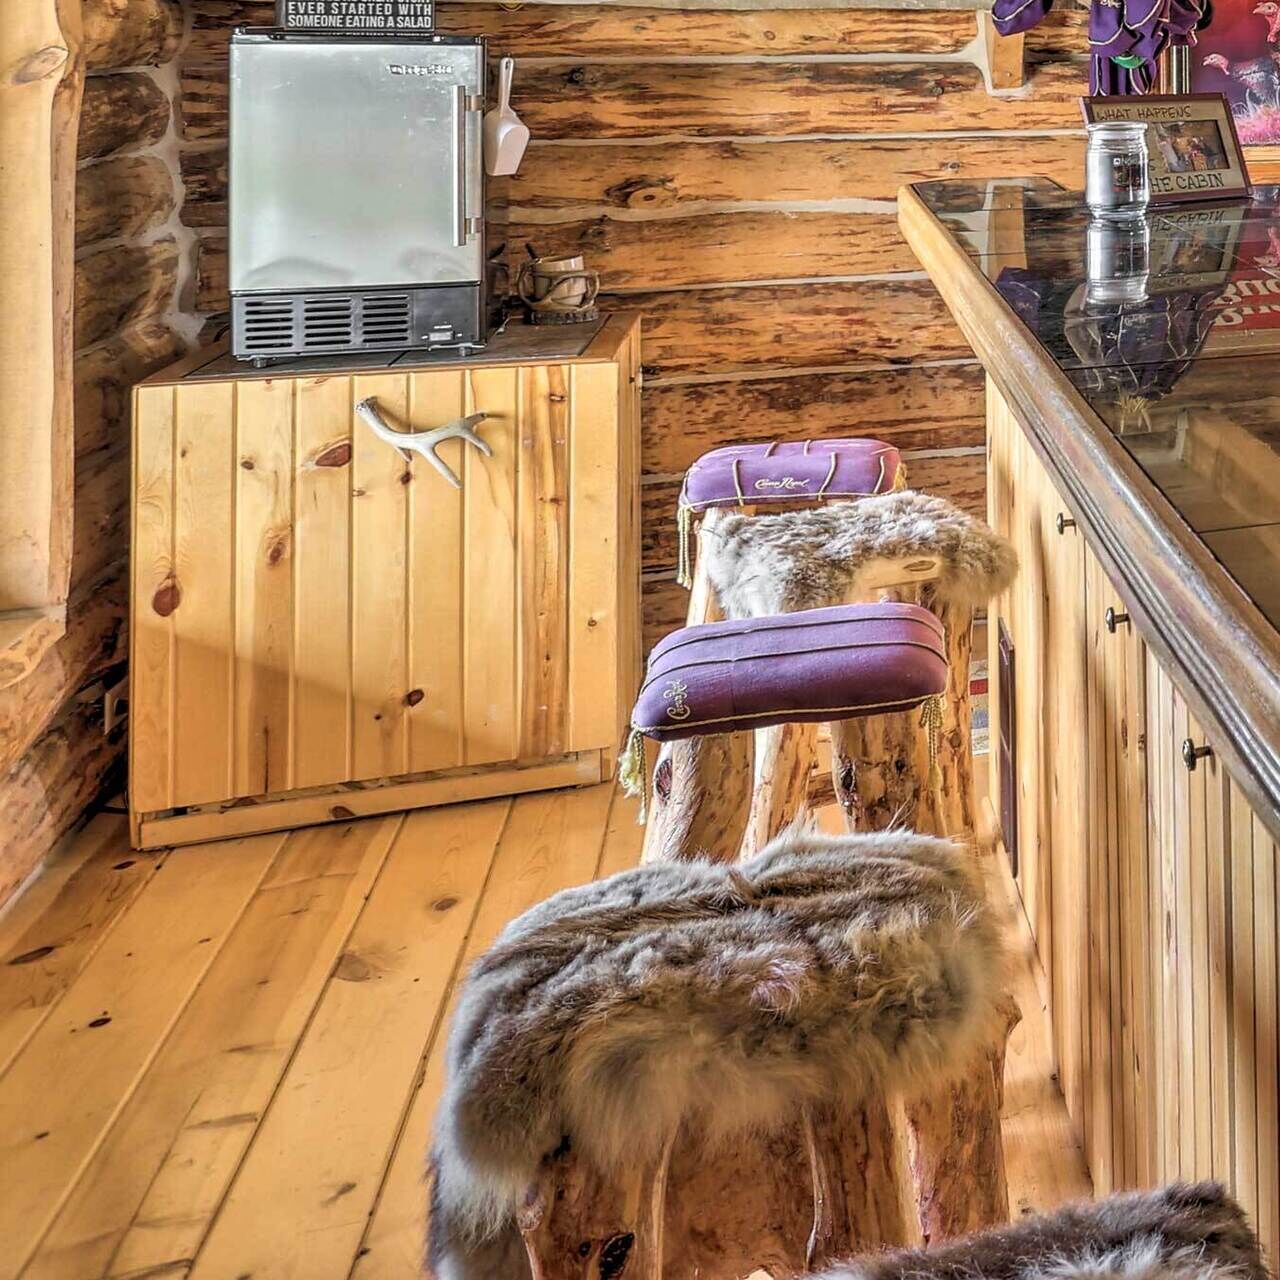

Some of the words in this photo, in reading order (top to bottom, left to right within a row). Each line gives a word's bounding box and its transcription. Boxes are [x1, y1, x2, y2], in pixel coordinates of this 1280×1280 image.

[288, 3, 325, 14] EVER
[331, 3, 392, 15] STARTED
[398, 3, 432, 16] WITH
[288, 15, 345, 27] SOMEONE
[345, 15, 385, 28] EATING
[386, 16, 393, 28] A
[394, 16, 432, 29] SALAD
[1096, 108, 1131, 121] WHAT
[1138, 105, 1192, 119] HAPPENS
[1151, 175, 1175, 193] HE
[1176, 173, 1225, 190] CABIN
